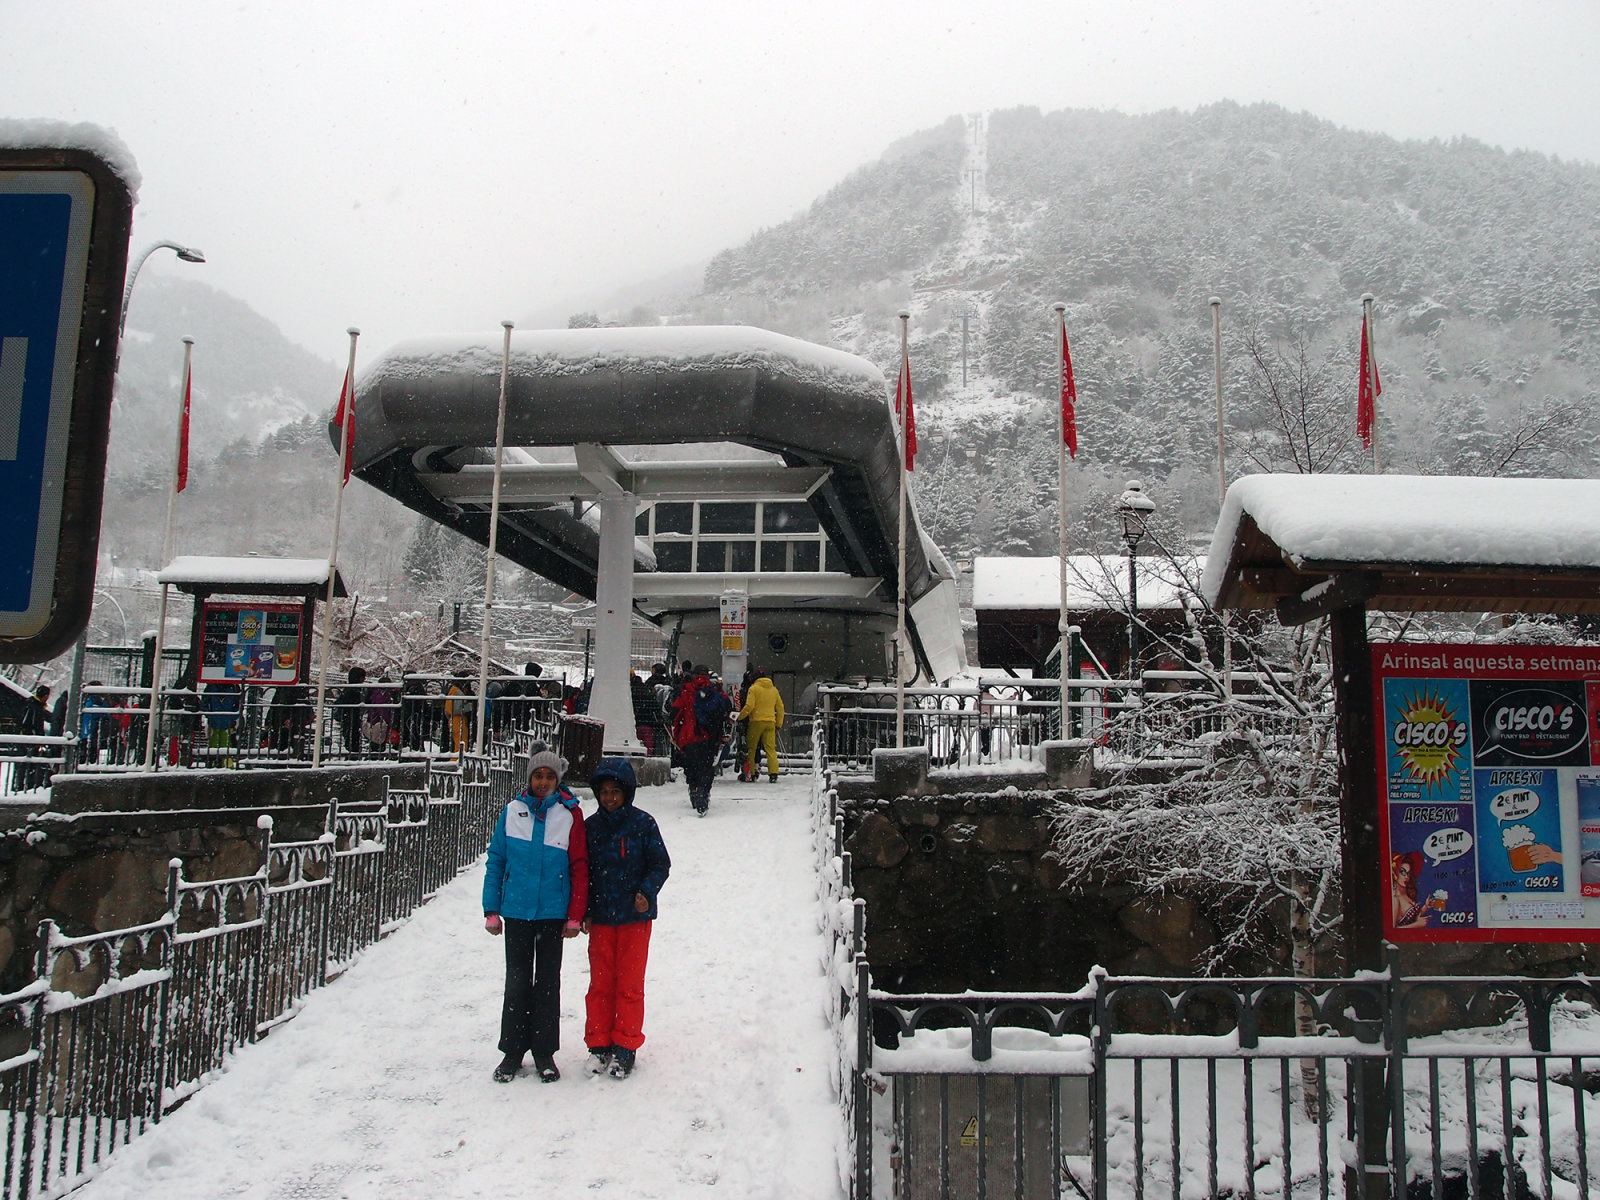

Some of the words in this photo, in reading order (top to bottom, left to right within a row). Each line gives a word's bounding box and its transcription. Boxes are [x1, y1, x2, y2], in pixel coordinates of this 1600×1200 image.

[1381, 653, 1448, 669] Arinsal
[1453, 655, 1525, 673] aquesta
[1495, 704, 1574, 731] CISCO'S
[1394, 720, 1468, 746] CISCO'S
[1489, 770, 1543, 786] APRESKI
[1512, 791, 1530, 803] PINT
[1403, 807, 1458, 823] APRESKI
[1446, 832, 1464, 843] PINT
[1524, 875, 1559, 888] CISCO'S
[1440, 911, 1474, 924] CISCO'S
